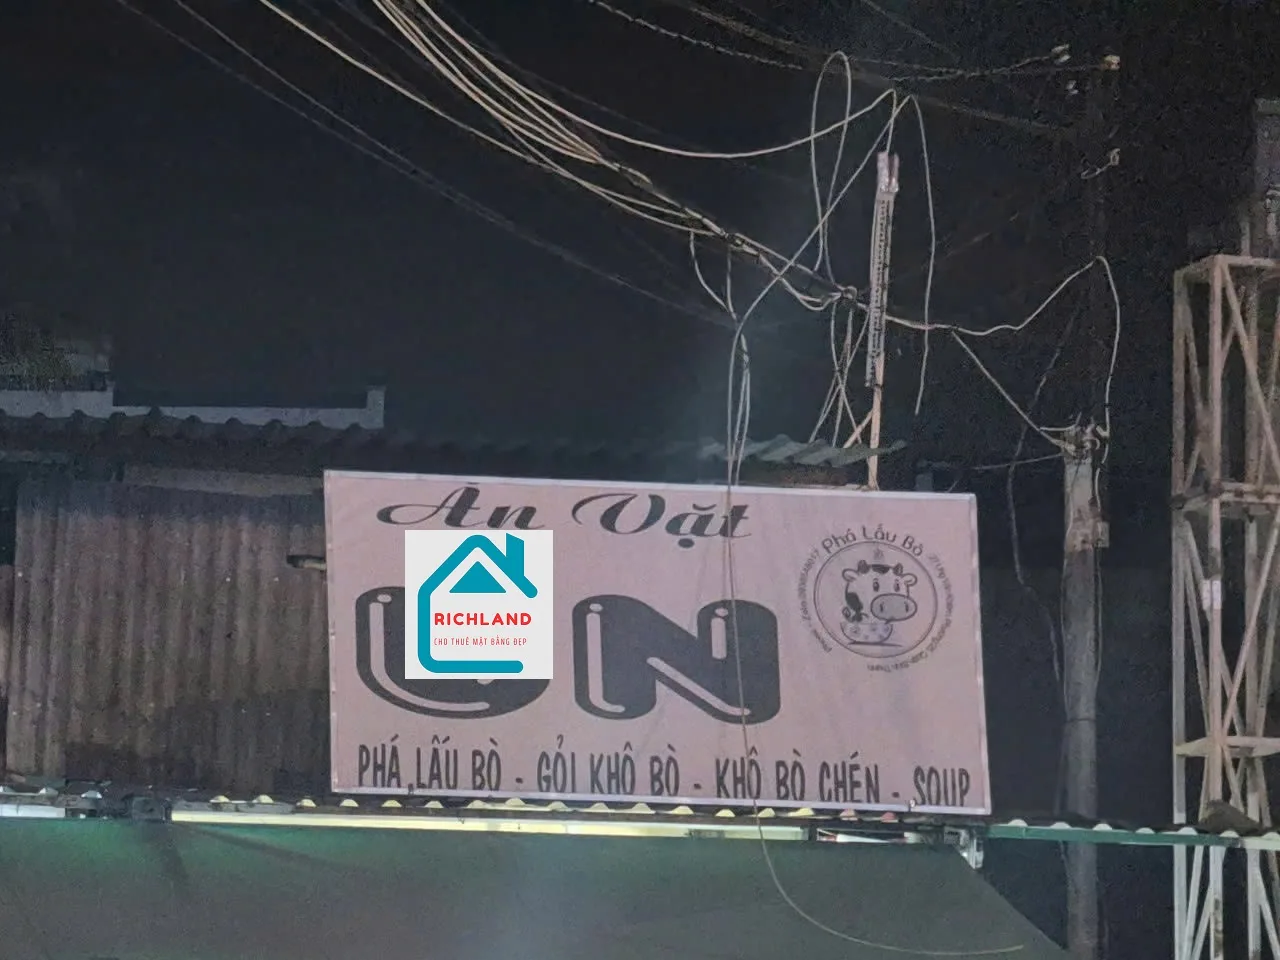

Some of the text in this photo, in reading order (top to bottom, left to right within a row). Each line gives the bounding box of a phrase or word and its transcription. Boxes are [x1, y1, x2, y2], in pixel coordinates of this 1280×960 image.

[571, 492, 753, 549] Vặt
[358, 734, 402, 788] PHÁ
[416, 735, 459, 790] LẤU
[471, 737, 502, 791] BÒ
[536, 734, 576, 794] GỎI
[589, 741, 636, 796] KHÔ
[649, 743, 680, 797] BÒ
[715, 746, 762, 800] KHÔ
[775, 748, 806, 801] BÒ
[819, 751, 881, 804] CHÉN
[913, 765, 971, 808] SOUP
